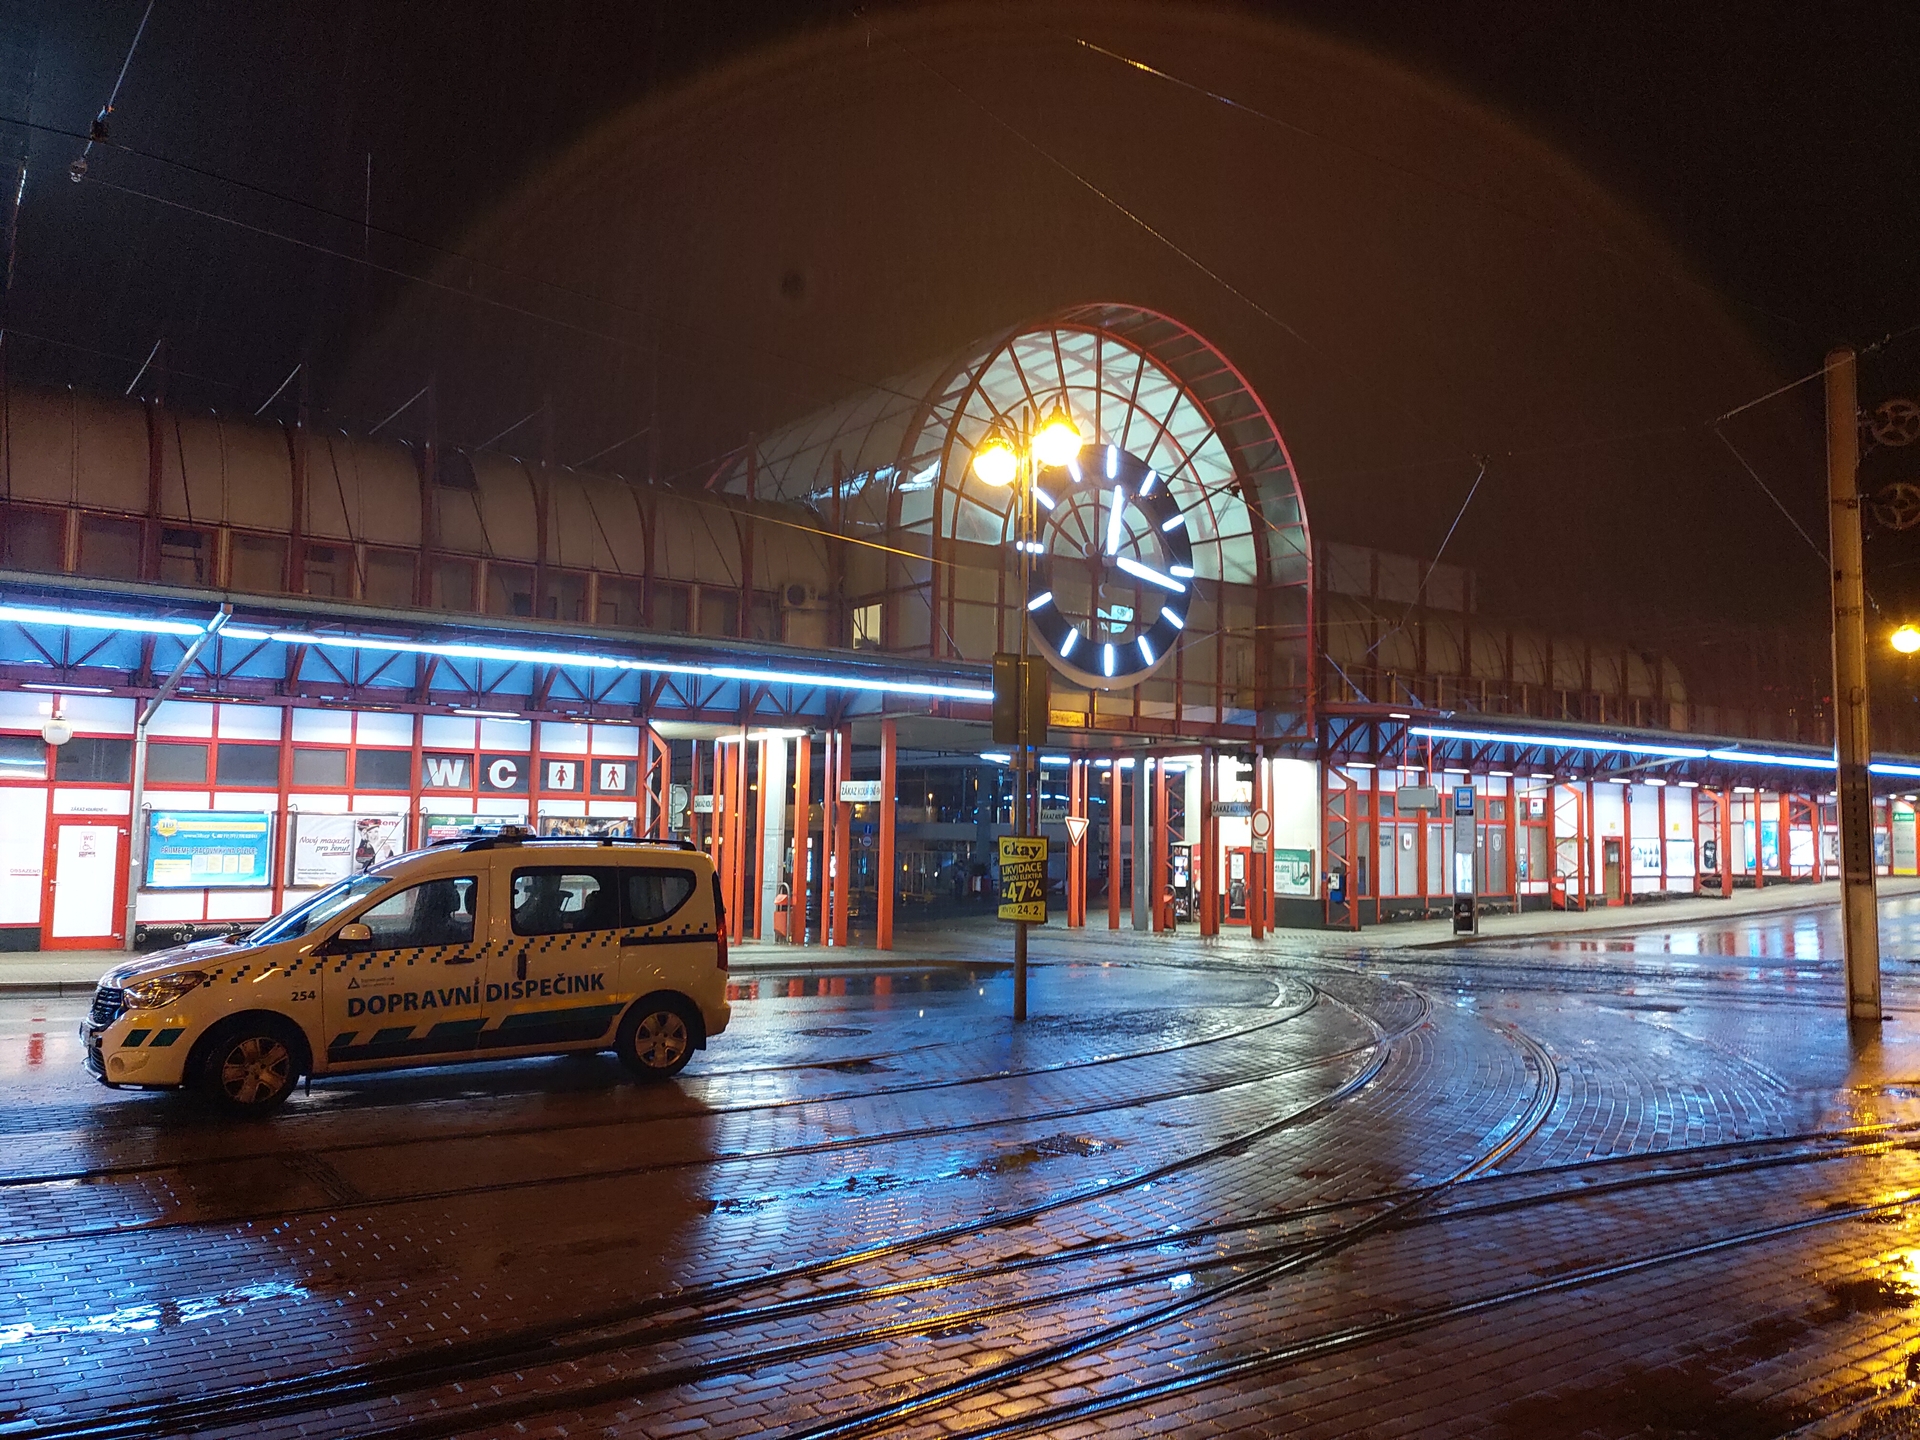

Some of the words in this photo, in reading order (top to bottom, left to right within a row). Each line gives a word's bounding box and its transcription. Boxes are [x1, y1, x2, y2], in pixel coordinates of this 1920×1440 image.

[1213, 804, 1230, 813] ZÁKAZ
[299, 836, 319, 846] Nový
[319, 836, 350, 846] magazín
[315, 845, 329, 853] pro
[330, 843, 350, 853] ženy!
[1002, 862, 1042, 876] LIKVIDACE
[1020, 872, 1043, 881] ELEKTRA
[291, 990, 316, 1002] 254
[347, 983, 480, 1018] DOPRAVNÍ
[486, 973, 604, 1003] DISPEČINK
